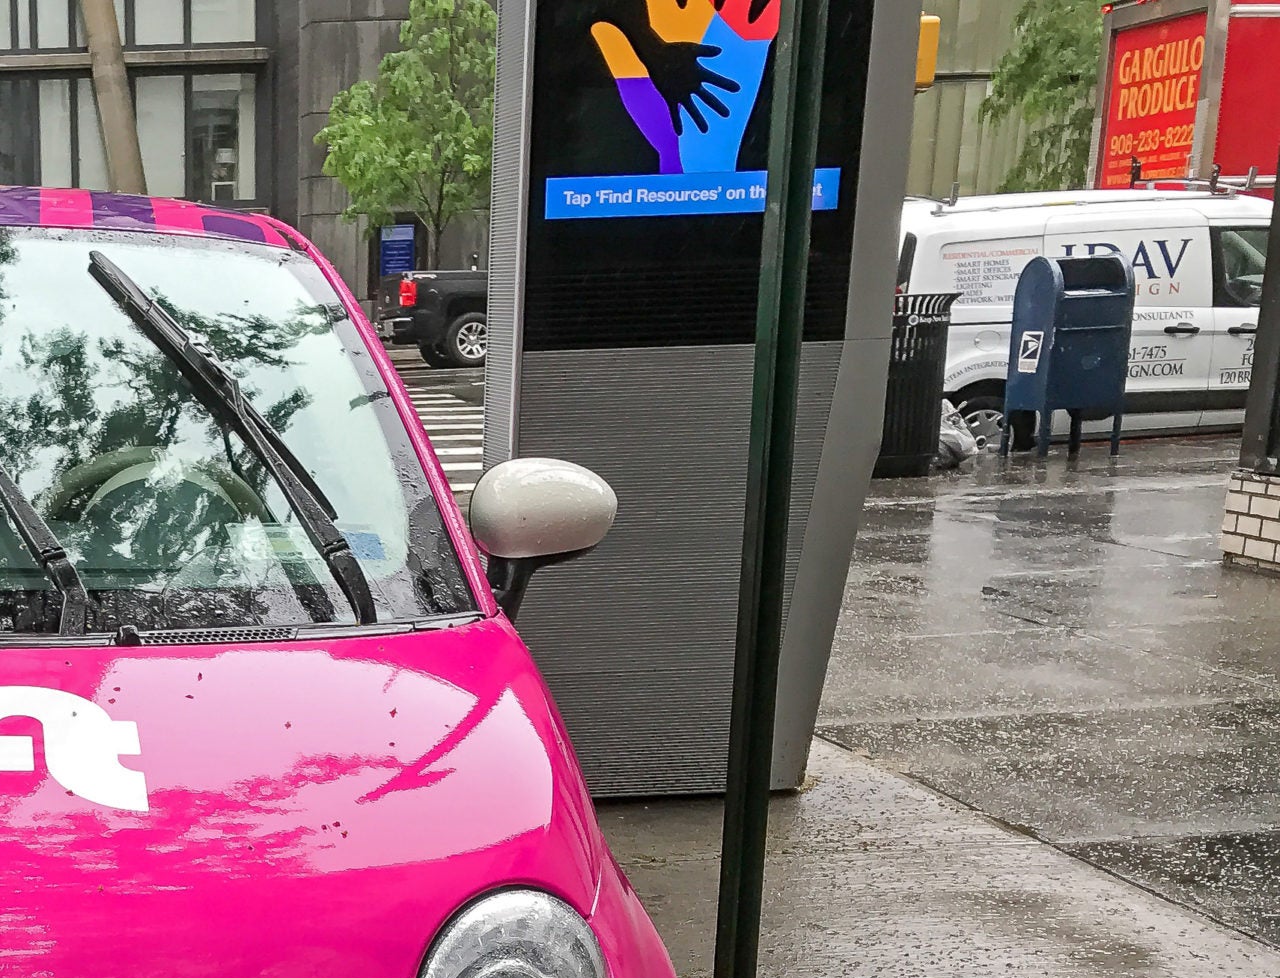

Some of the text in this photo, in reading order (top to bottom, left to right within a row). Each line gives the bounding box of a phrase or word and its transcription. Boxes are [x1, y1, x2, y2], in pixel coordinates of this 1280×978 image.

[1120, 35, 1205, 84] GARGIULO
[1118, 75, 1197, 120] PRODUCE
[1111, 124, 1194, 155] 908-233-8222
[563, 191, 591, 207] Tap
[726, 188, 744, 199] on
[749, 186, 766, 199] th
[1132, 311, 1194, 322] ONSULTANTS
